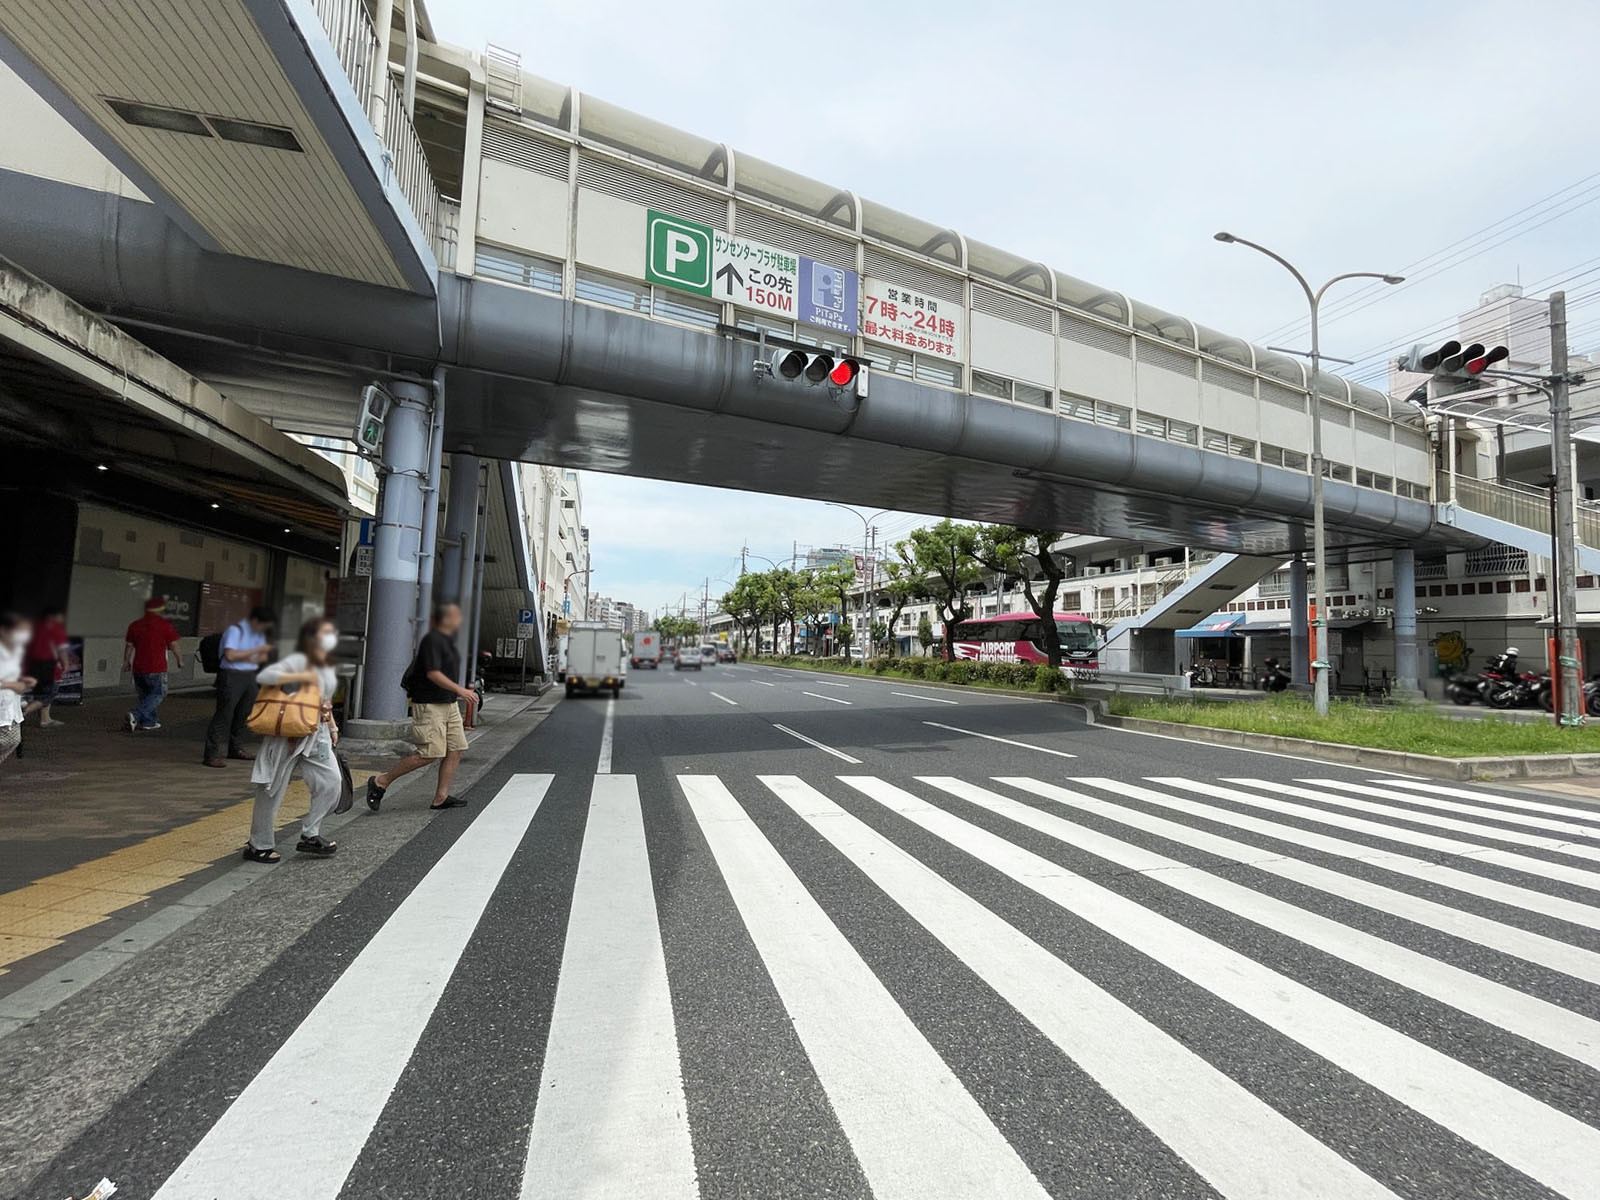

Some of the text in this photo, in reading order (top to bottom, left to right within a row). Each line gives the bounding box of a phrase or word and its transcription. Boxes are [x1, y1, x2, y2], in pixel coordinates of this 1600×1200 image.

[666, 229, 699, 274] P
[715, 235, 797, 276] サンセンタープラザ駐車場
[748, 268, 793, 295] この先
[745, 285, 792, 313] 150M
[887, 288, 938, 313] 営業時間
[815, 306, 843, 322] PiTaPa
[864, 320, 957, 358] 最大料金あります。
[522, 610, 532, 622] P
[980, 641, 1016, 654] AIRPORT
